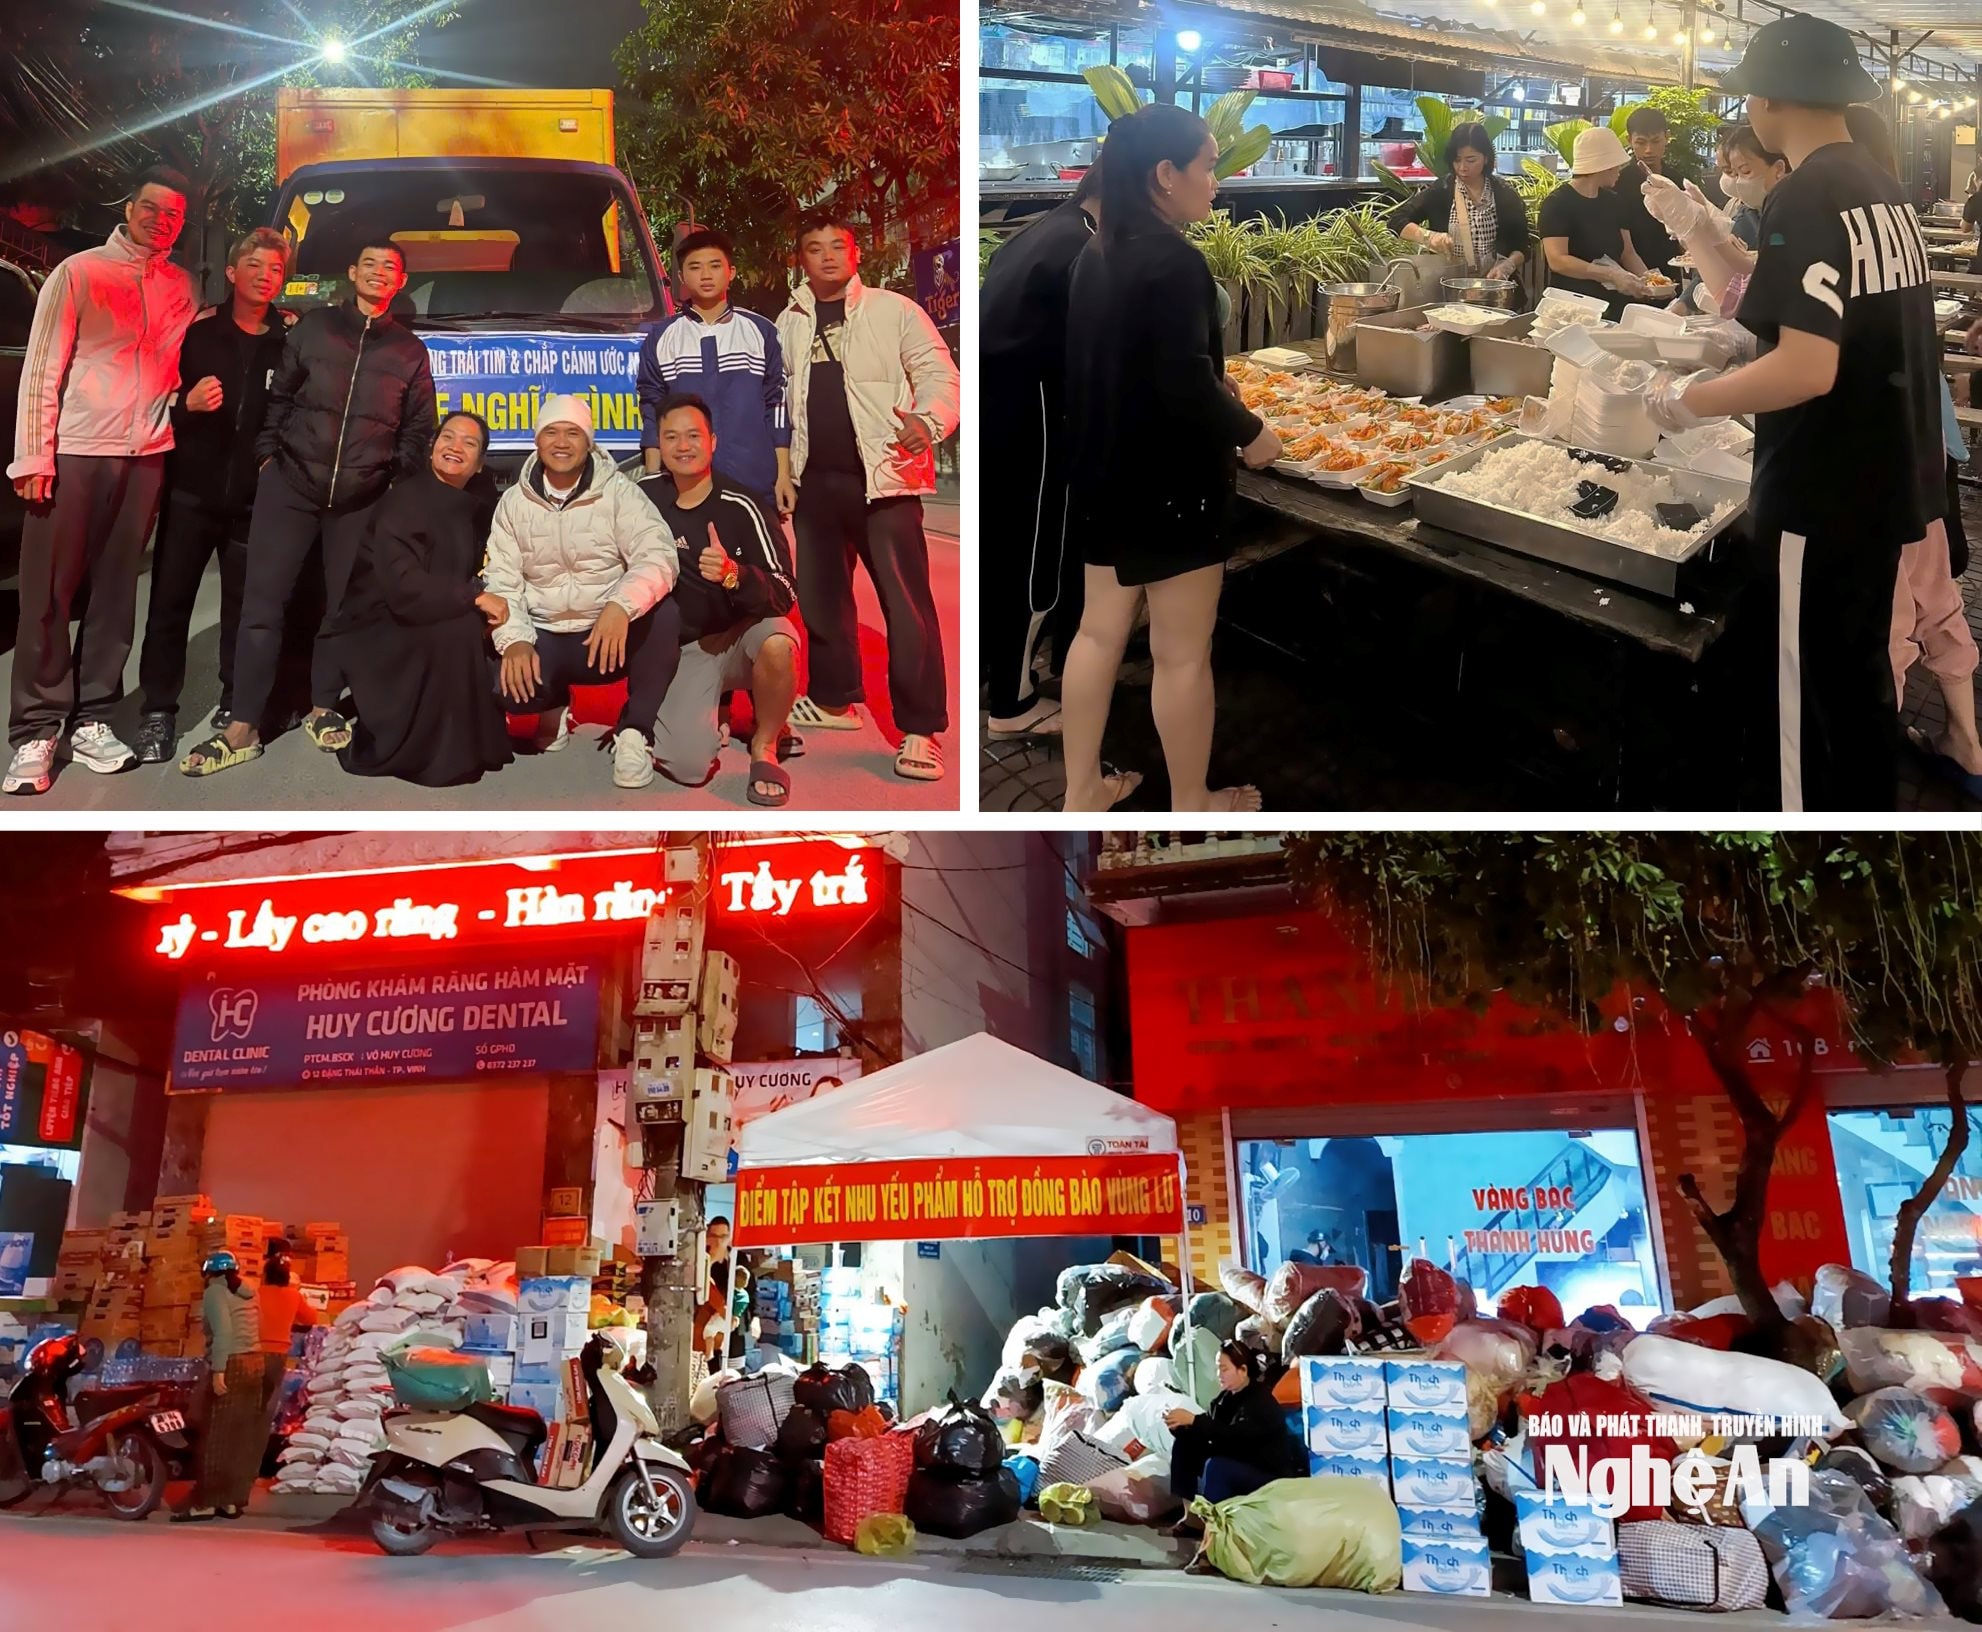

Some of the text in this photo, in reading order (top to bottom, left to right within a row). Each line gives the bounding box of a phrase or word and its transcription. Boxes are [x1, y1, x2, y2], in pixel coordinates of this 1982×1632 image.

[925, 288, 959, 320] Tiger
[510, 352, 519, 374] &
[562, 346, 596, 374] CÁNH
[462, 385, 557, 430] NGHĨ
[302, 913, 368, 943] cao
[297, 963, 589, 1002] PHÒNG KHÁM RĂNG HÀM MẶT
[306, 1000, 568, 1039] HUY CƯƠNG DENTAL
[183, 1046, 270, 1063] DENTAL CLINIC
[381, 1050, 399, 1060] HUY
[759, 1072, 811, 1088] CƯƠNG
[740, 1174, 777, 1227] ĐIỂM
[781, 1180, 809, 1233] TẬP
[814, 1174, 841, 1224] KẾT
[845, 1184, 876, 1223] NHU
[880, 1170, 909, 1221] YẾU
[913, 1165, 958, 1219] PHẨM
[962, 1166, 984, 1217] HỖ
[987, 1175, 1018, 1226] TRỢ
[1069, 1169, 1102, 1216] BÀO
[1106, 1169, 1151, 1215] VÙNG
[1472, 1183, 1529, 1211] VÀNG
[1464, 1226, 1595, 1254] THANH HÙNG
